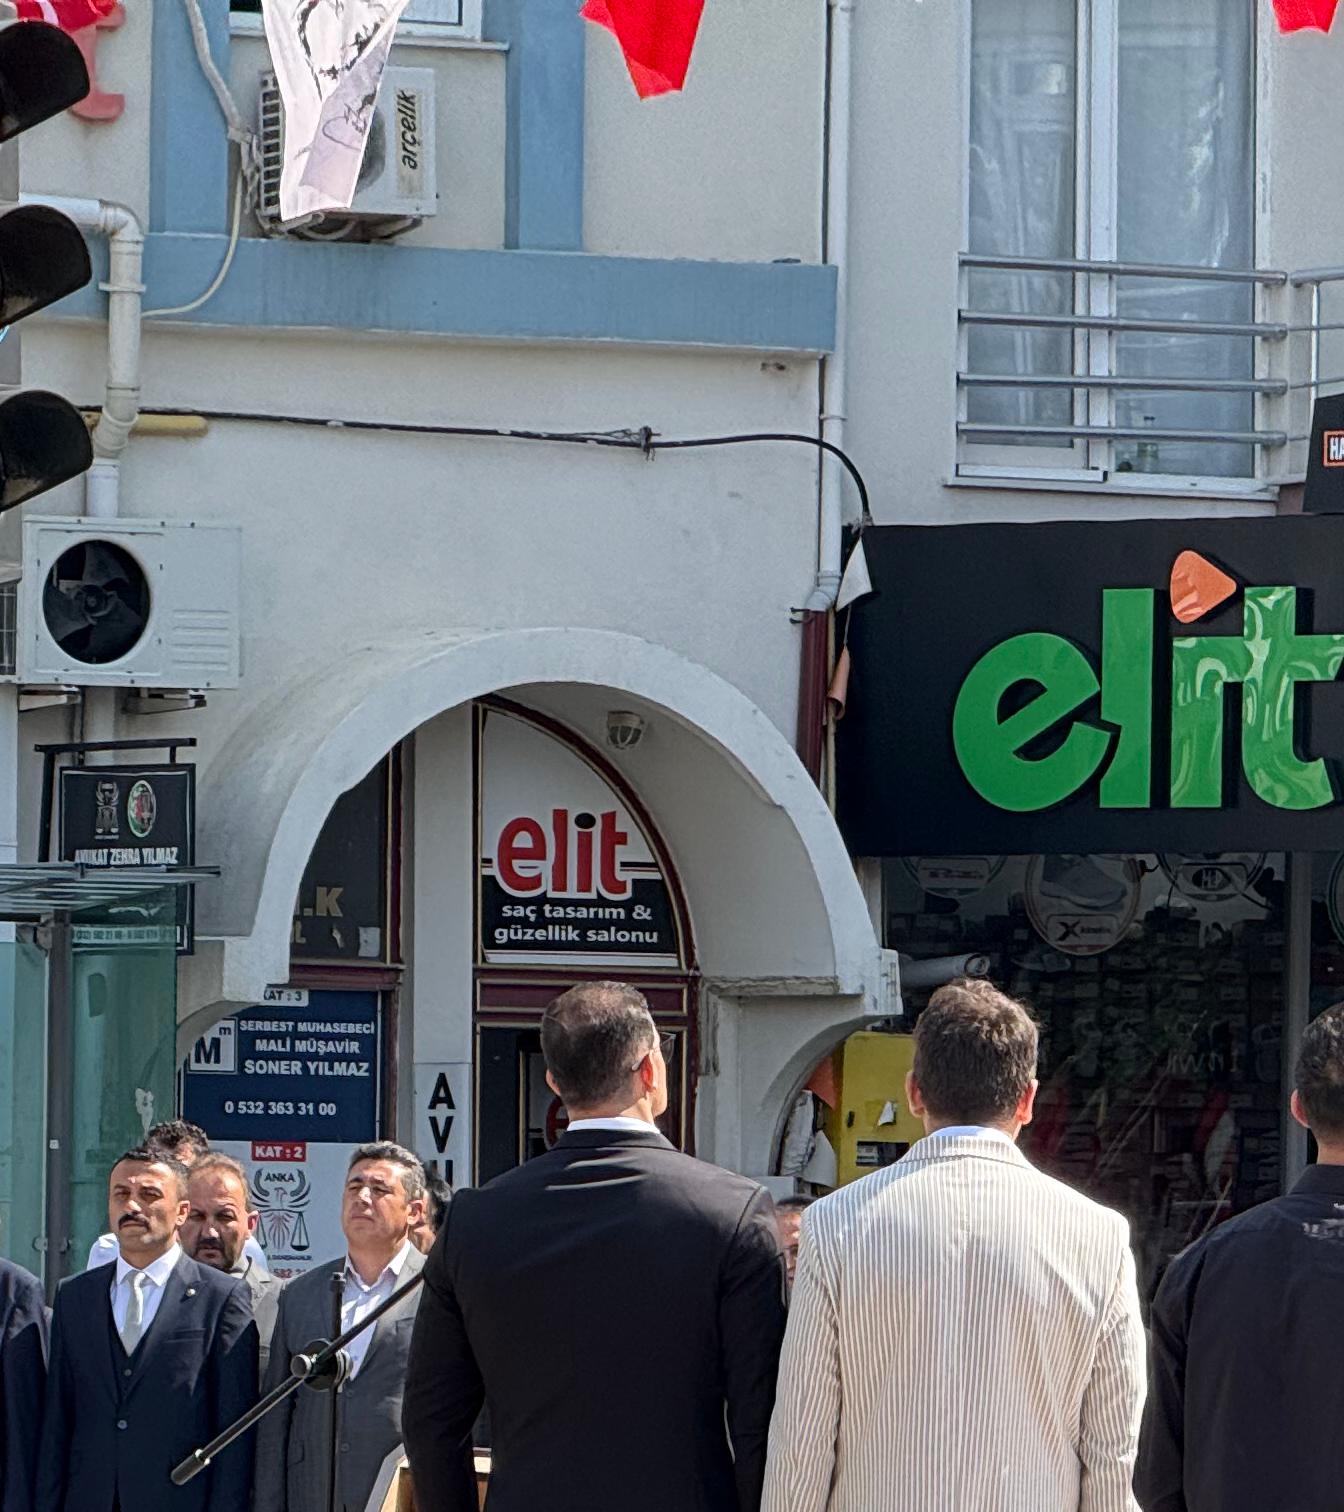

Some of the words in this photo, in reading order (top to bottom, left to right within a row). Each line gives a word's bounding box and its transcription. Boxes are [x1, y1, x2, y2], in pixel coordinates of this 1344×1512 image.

[396, 89, 421, 170] arçelik
[142, 847, 178, 865] YILMAZ
[497, 809, 628, 895] elit
[501, 904, 537, 922] saç
[543, 903, 625, 920] tasarım
[632, 904, 653, 920] &
[494, 925, 581, 944] güzellik
[586, 926, 658, 943] salonu
[239, 1020, 294, 1033] SERBEST
[297, 1021, 375, 1035] MUHASEBECİ
[255, 1037, 291, 1054] MALİ
[295, 1038, 360, 1056] MÜŞAVİR
[244, 1060, 303, 1076] SONER
[307, 1061, 370, 1077] YILMAZ
[224, 1101, 235, 1115] 0
[237, 1101, 265, 1115] 532
[267, 1101, 295, 1115] 363
[297, 1102, 314, 1116] 31
[318, 1102, 337, 1116] 00
[255, 1146, 283, 1158] KAT
[294, 1146, 304, 1159] 2
[264, 1172, 296, 1184] ANKA
